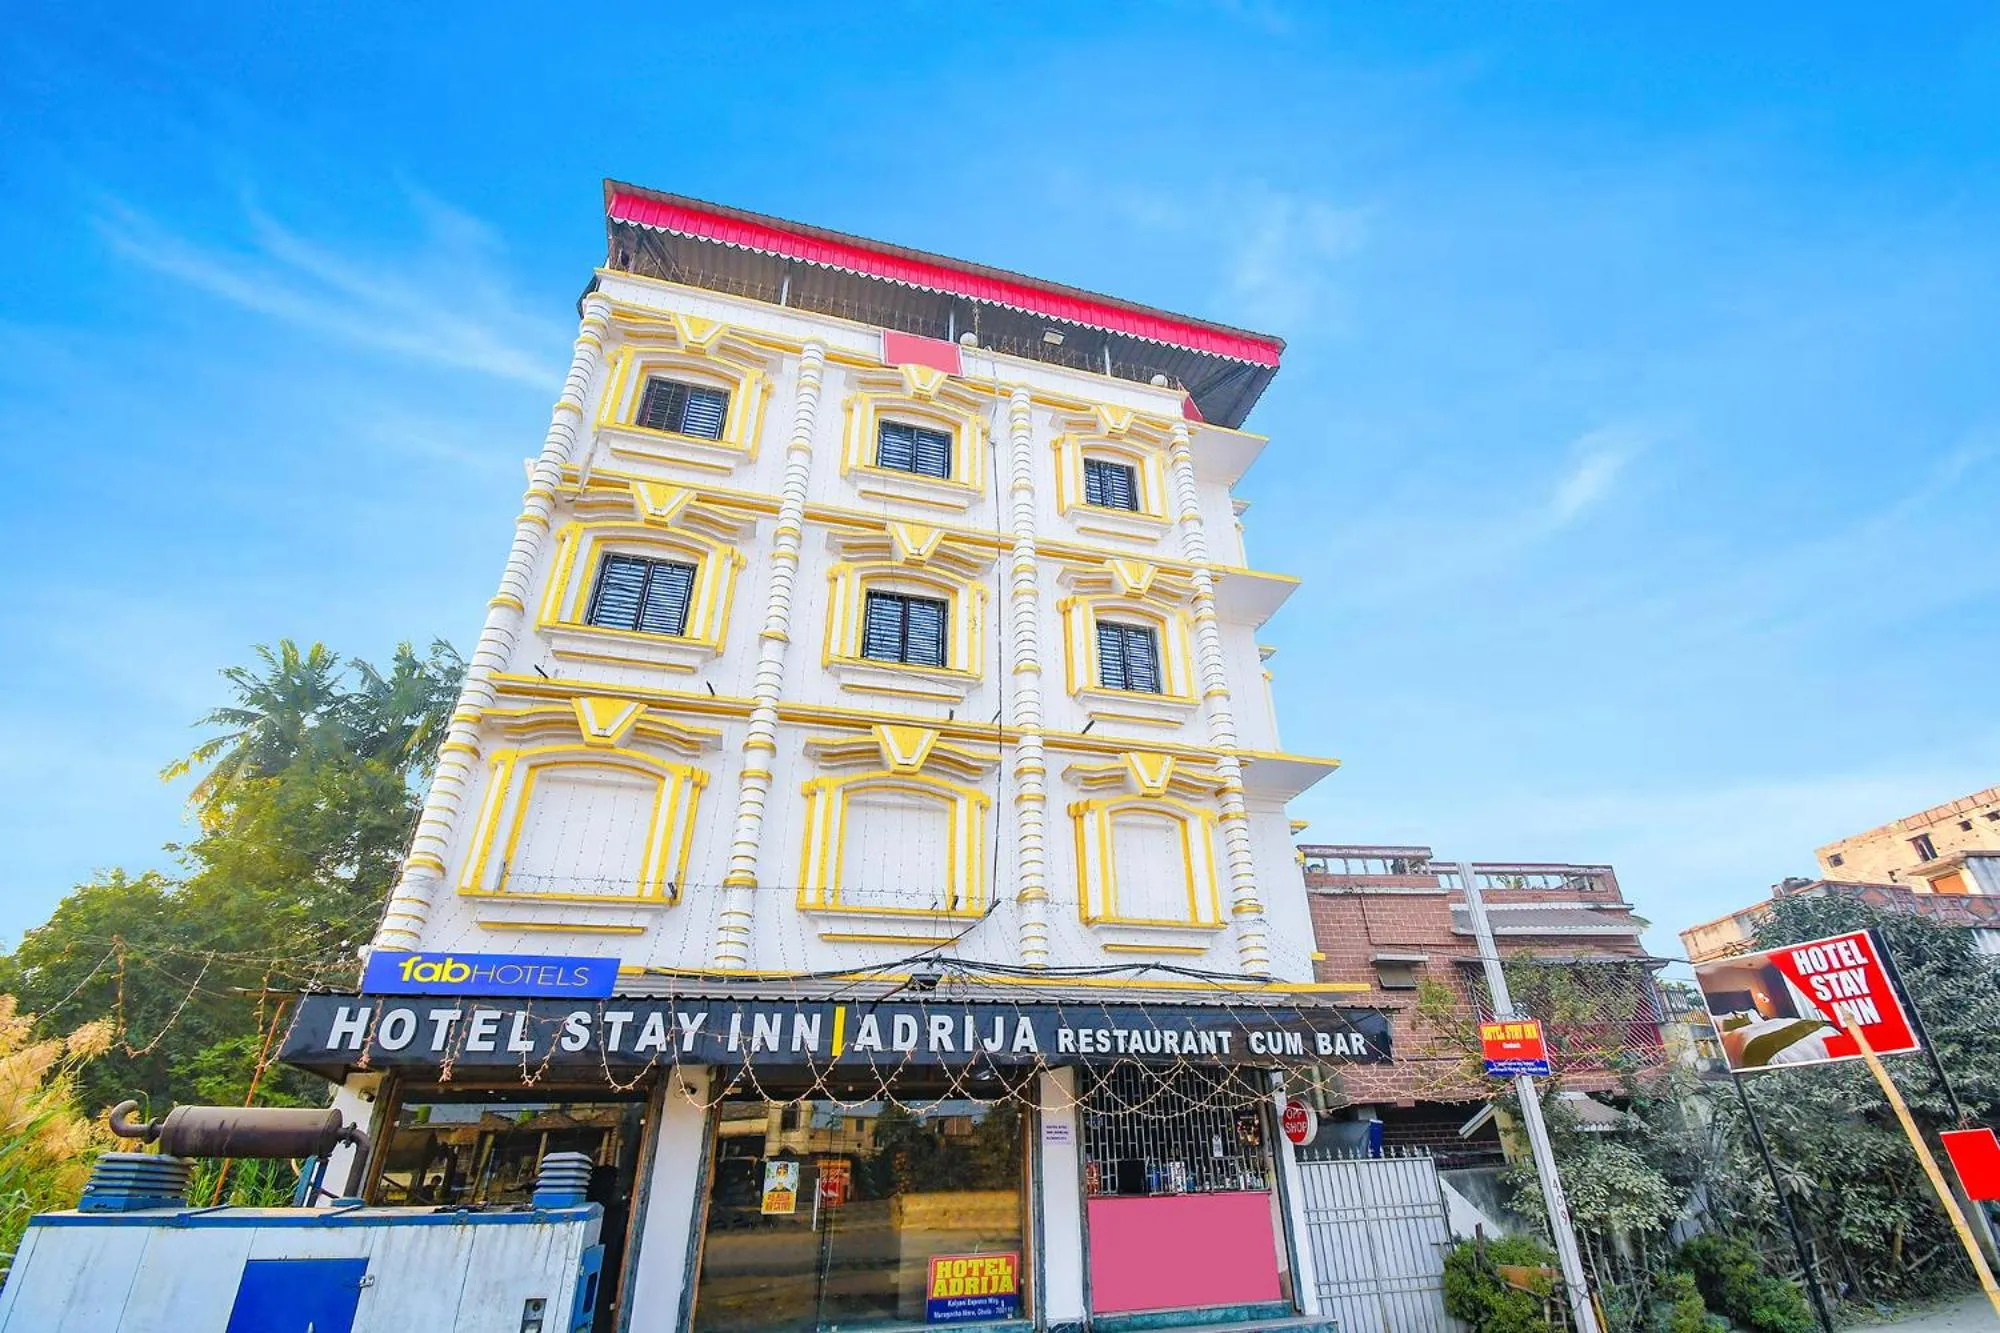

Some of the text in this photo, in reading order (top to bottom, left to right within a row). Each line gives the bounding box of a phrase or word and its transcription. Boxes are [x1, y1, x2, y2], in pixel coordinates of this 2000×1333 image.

[1791, 939, 1869, 975] HOTEL
[1809, 967, 1871, 1002] STAY
[1831, 997, 1882, 1028] INN
[326, 1006, 1368, 1055] HOTEL STAY INN ADRIJA RESTAURANT CUM BAR
[1285, 1121, 1307, 1134] SHOP
[1287, 1109, 1303, 1120] OFF
[936, 1257, 1013, 1279] HOTEL
[932, 1275, 1015, 1297] ADRIJA
